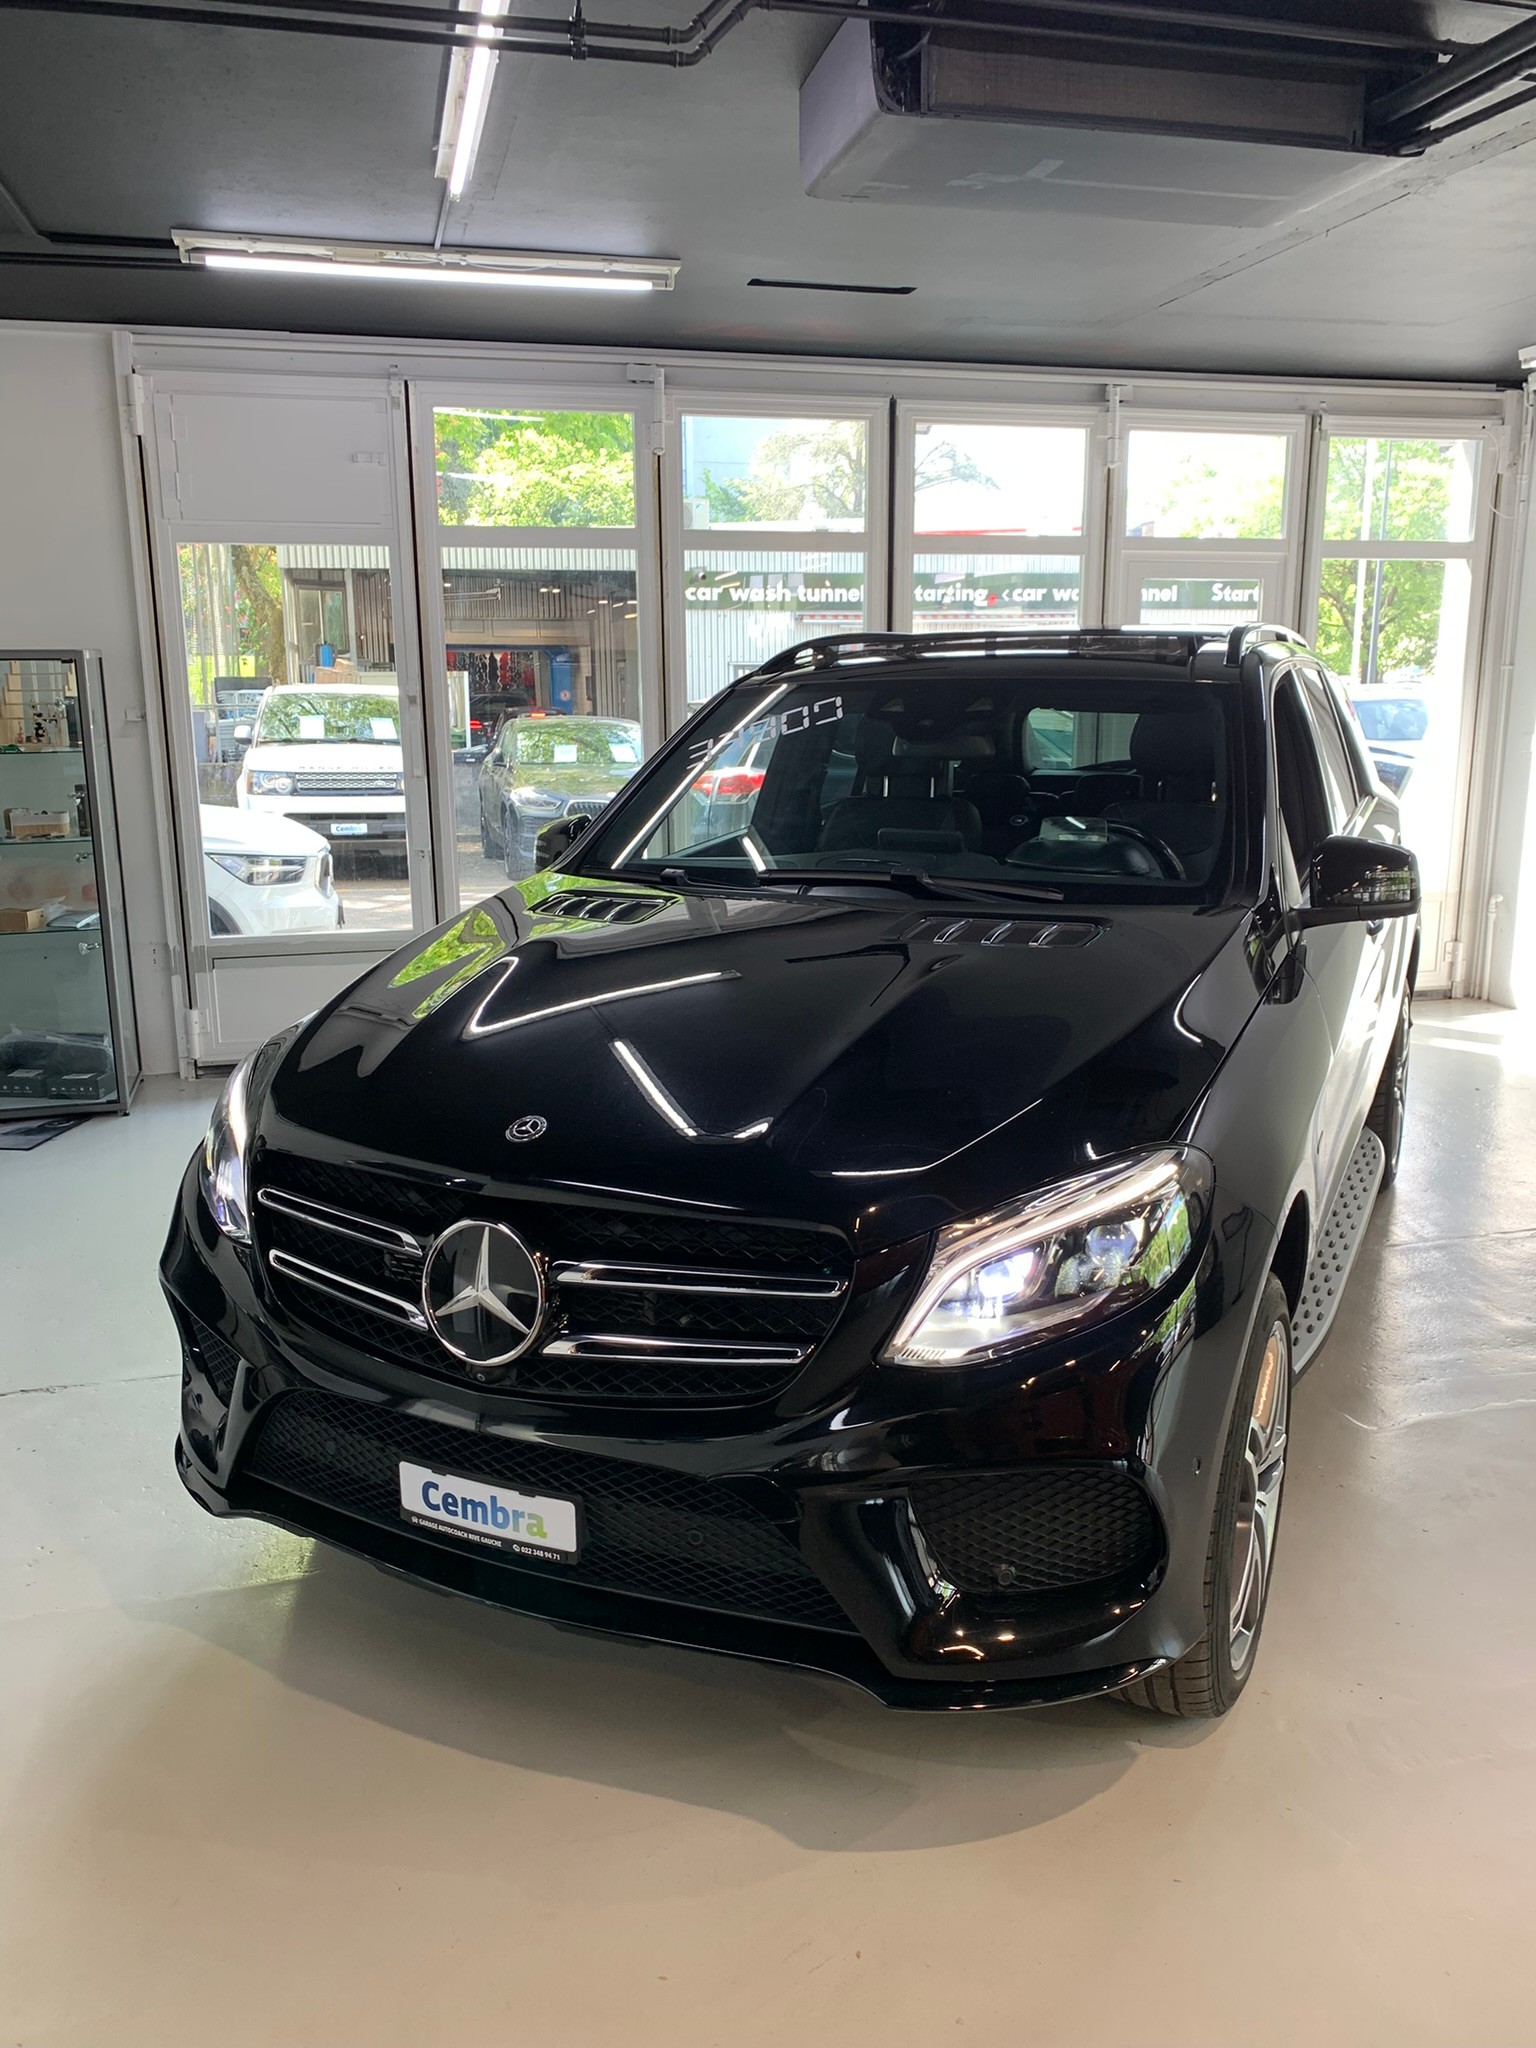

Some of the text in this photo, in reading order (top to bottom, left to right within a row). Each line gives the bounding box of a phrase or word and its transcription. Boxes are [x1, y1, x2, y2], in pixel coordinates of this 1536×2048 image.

[685, 587, 722, 601] car
[729, 580, 791, 602] wash
[914, 583, 989, 607] tarting
[1012, 587, 1047, 602] car
[422, 1481, 548, 1539] Cembra
[419, 1518, 438, 1530] GARAGE
[439, 1524, 468, 1538] AUTOCOACH
[481, 1536, 502, 1547] GAUCHE
